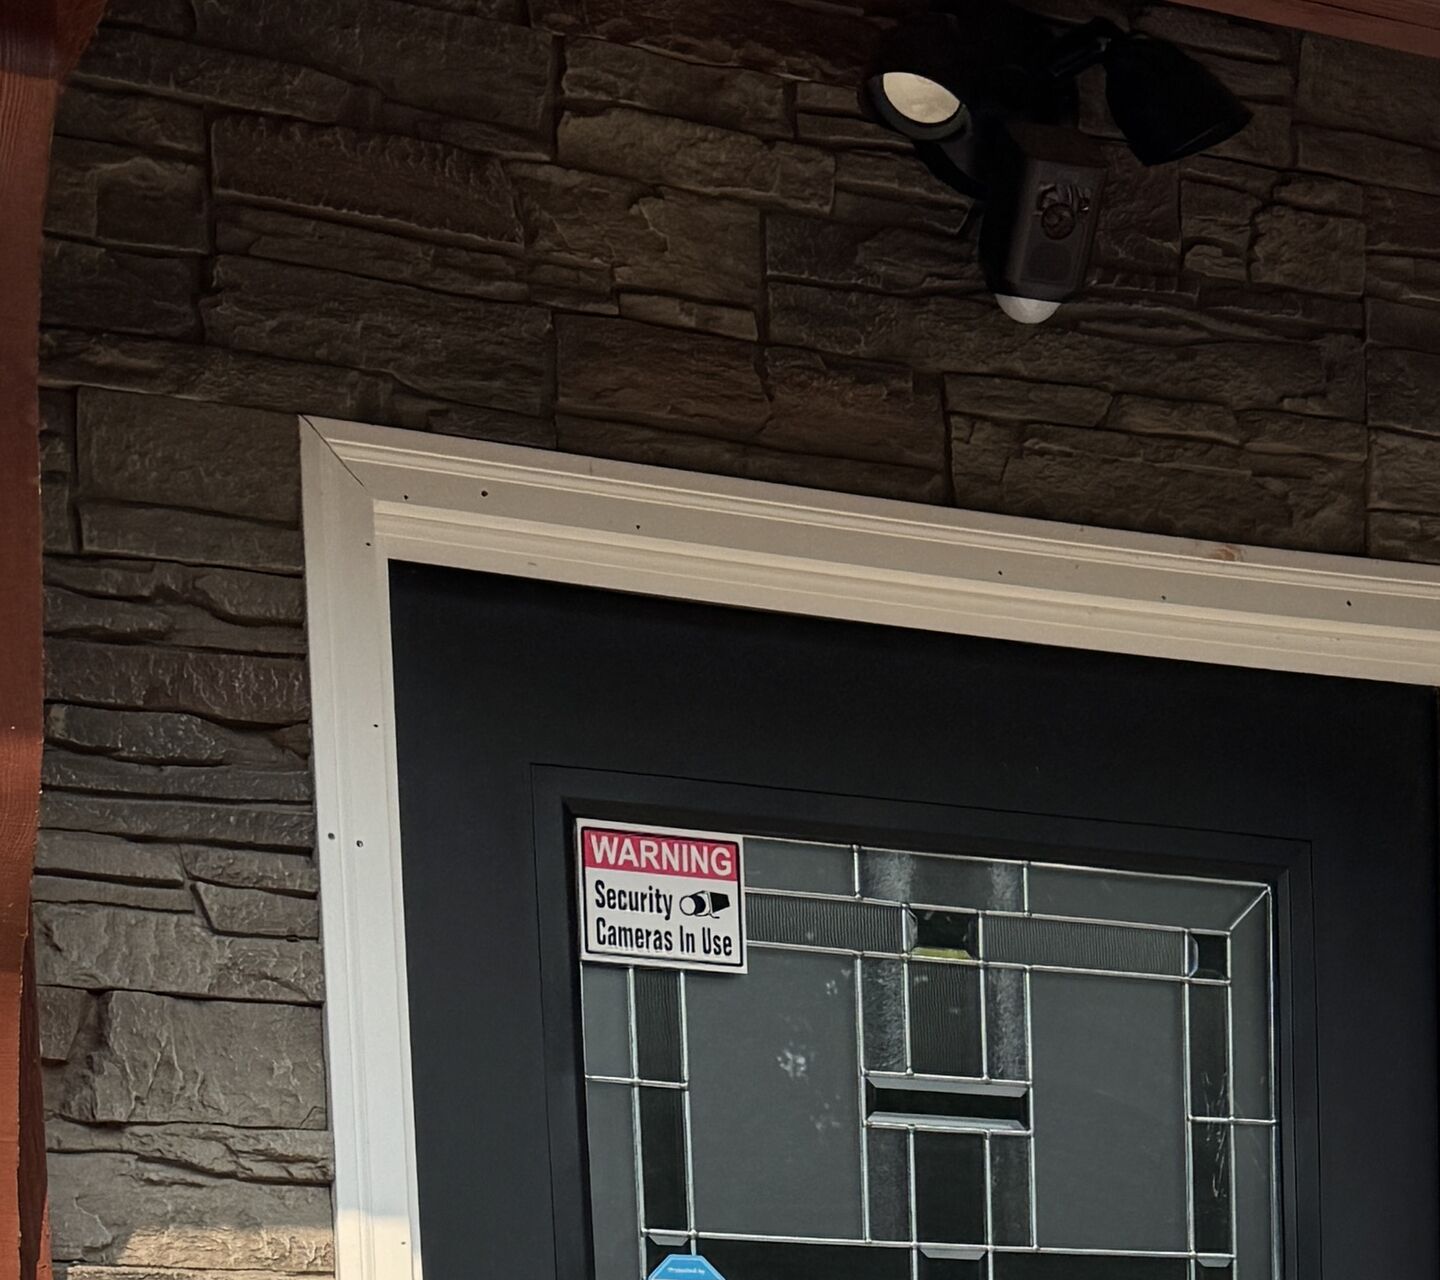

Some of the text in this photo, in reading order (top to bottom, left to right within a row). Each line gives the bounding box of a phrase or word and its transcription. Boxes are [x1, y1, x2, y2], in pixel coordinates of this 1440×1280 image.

[590, 834, 732, 876] WARNING
[595, 879, 673, 921] Security
[596, 917, 732, 956] Cameras In Use
